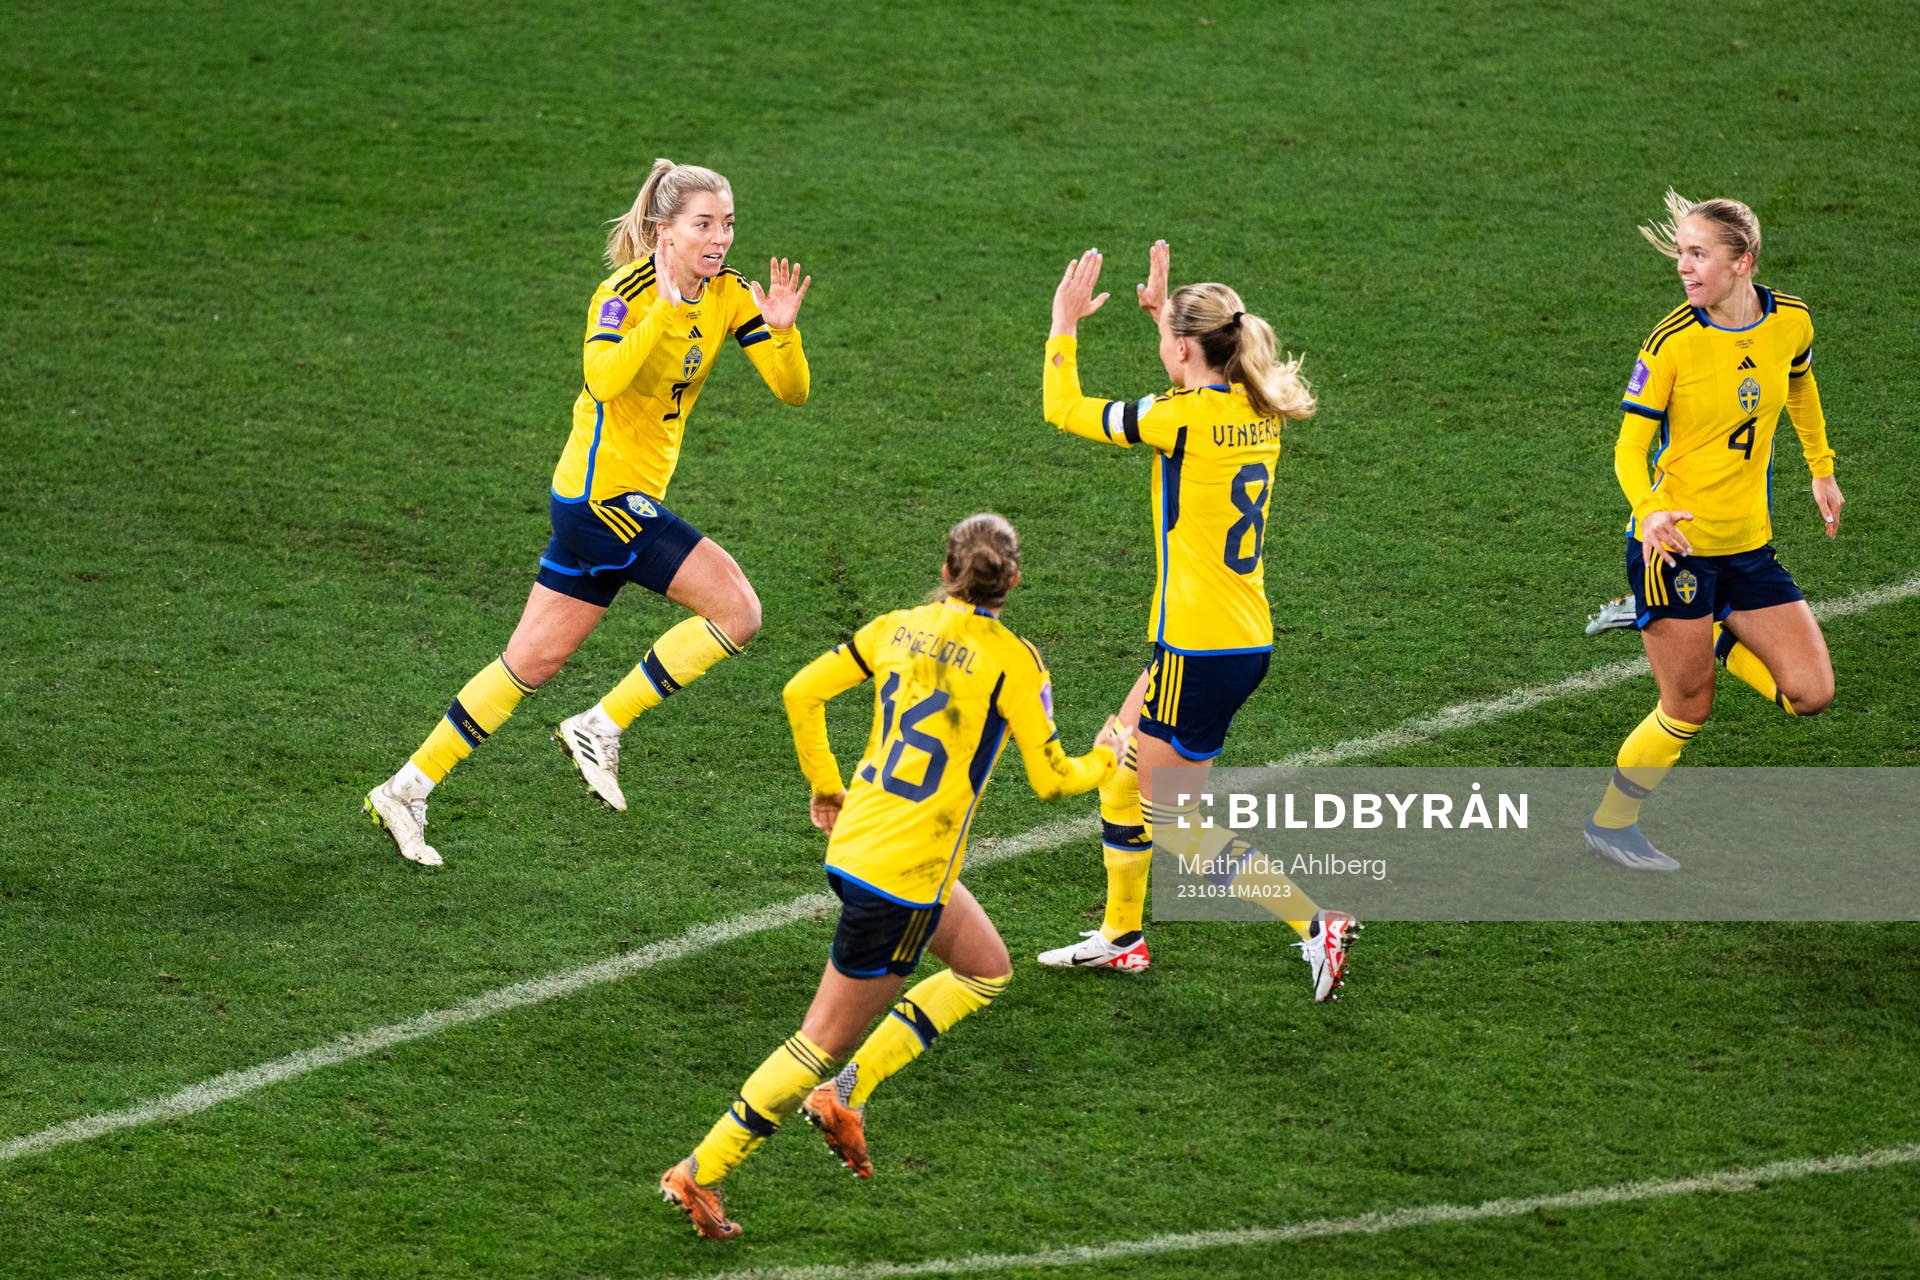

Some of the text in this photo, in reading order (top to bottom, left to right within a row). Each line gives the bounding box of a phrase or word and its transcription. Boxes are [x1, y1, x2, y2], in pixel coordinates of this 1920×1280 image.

[1213, 415, 1278, 447] VINBERG
[1728, 417, 1758, 460] 4
[1224, 462, 1269, 575] 8
[891, 626, 976, 674] ANGELDAL
[861, 671, 950, 803] 16
